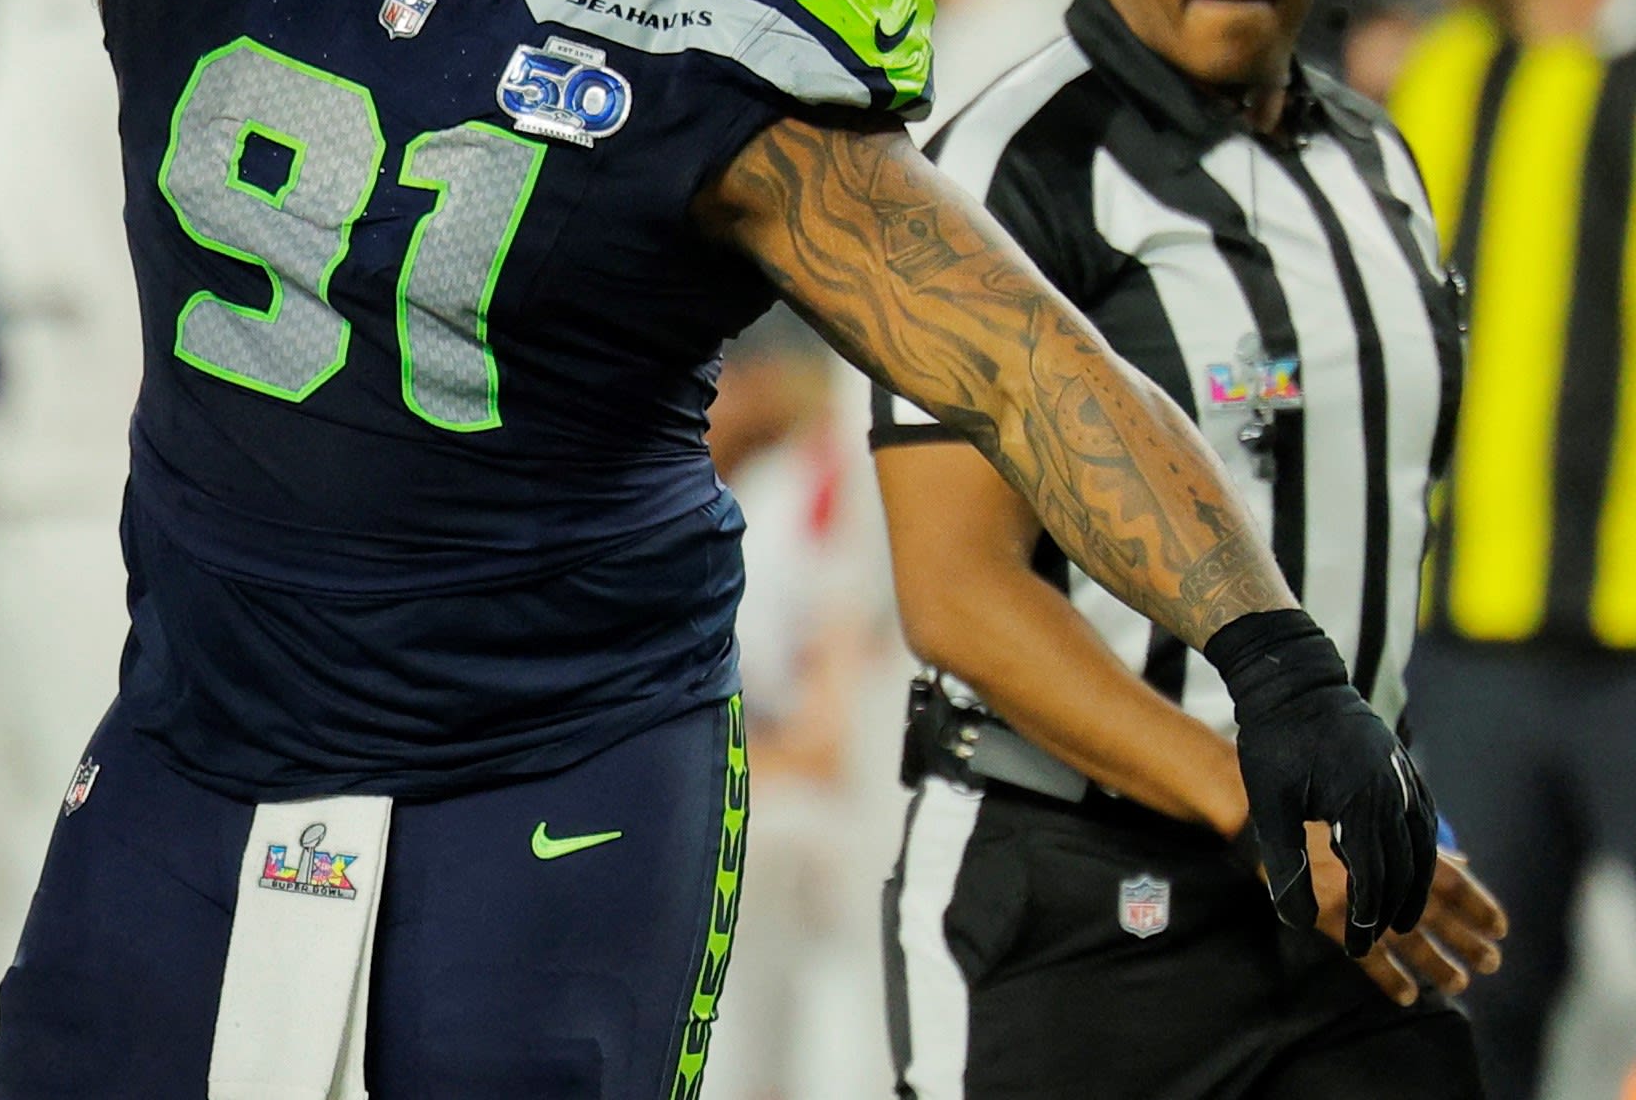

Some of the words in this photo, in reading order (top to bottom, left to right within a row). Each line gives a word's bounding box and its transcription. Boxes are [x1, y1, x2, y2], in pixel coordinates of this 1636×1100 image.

[502, 51, 626, 134] 50
[157, 34, 548, 433] 91
[271, 881, 309, 893] SUPER
[312, 885, 344, 897] BOWL
